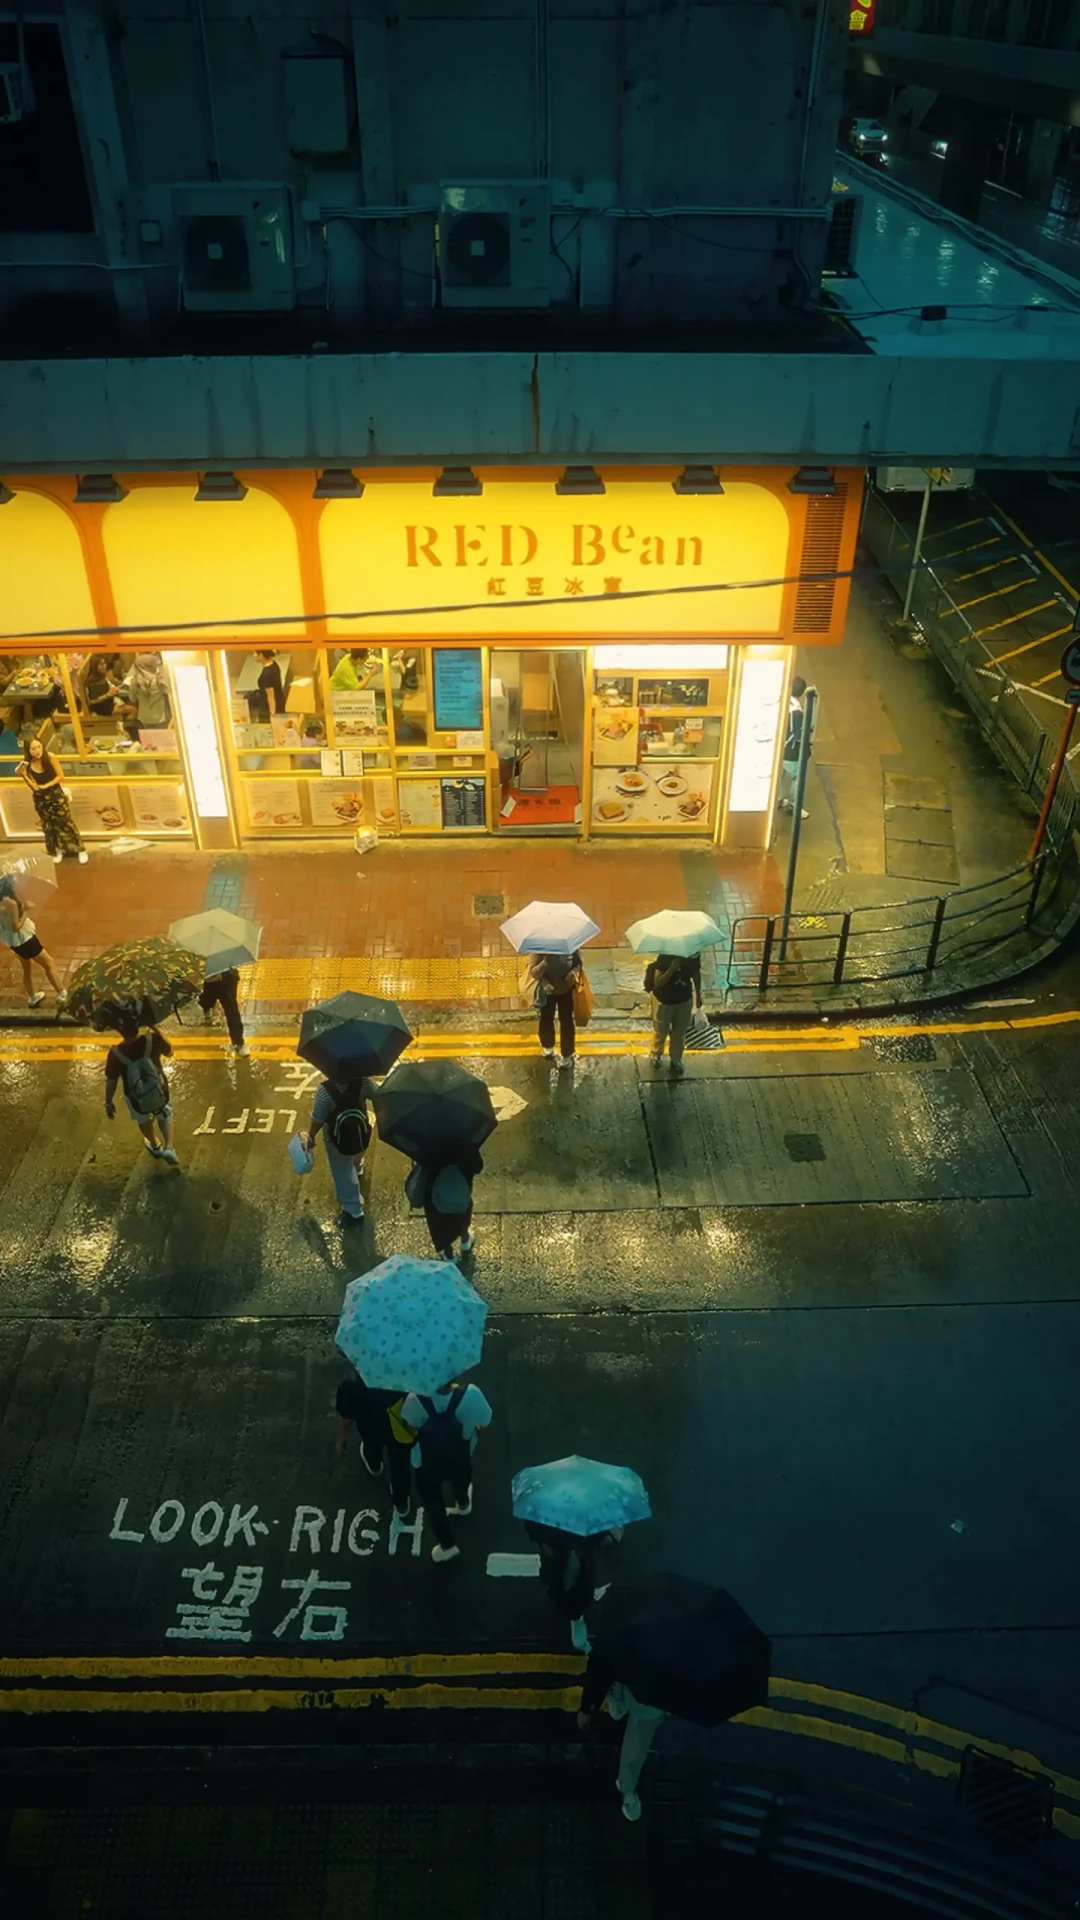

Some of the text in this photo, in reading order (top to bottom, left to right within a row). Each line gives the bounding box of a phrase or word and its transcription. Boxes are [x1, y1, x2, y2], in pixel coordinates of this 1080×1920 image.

[405, 523, 704, 567] RED Bean
[274, 1062, 328, 1100] 左
[193, 1105, 298, 1135] LEFT
[109, 1497, 425, 1557] LOOK RIGH
[165, 1562, 352, 1643] 望右
